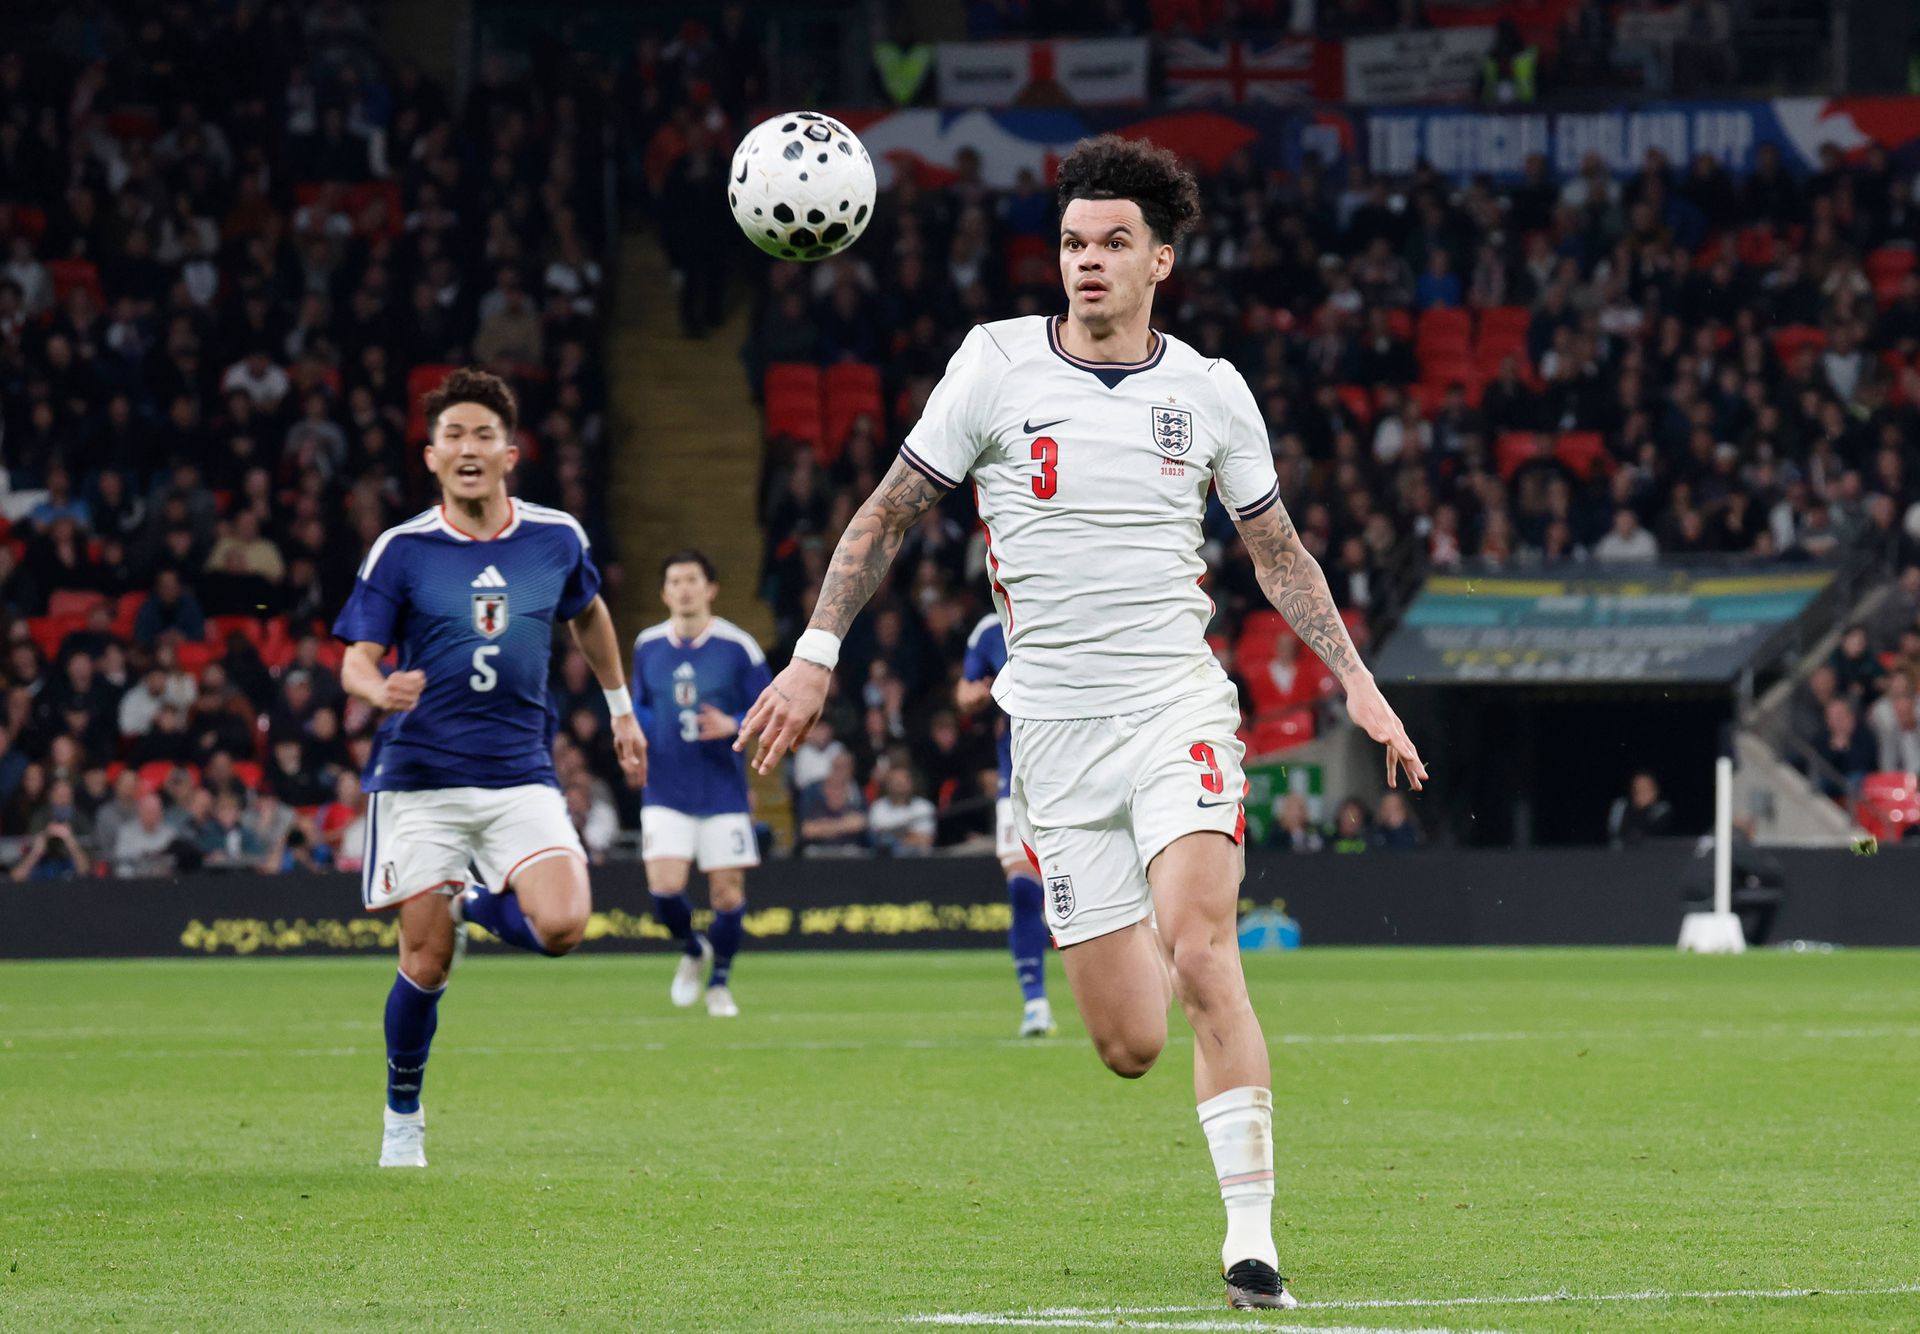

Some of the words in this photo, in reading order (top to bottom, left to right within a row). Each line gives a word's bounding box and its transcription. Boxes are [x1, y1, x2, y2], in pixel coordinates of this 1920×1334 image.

[1031, 437, 1058, 499] 3
[1160, 467, 1185, 476] 31.03.26
[1162, 457, 1184, 465] JAPAN
[469, 645, 500, 692] 5
[679, 709, 699, 742] 3
[1189, 742, 1224, 794] 3
[730, 829, 745, 855] 3
